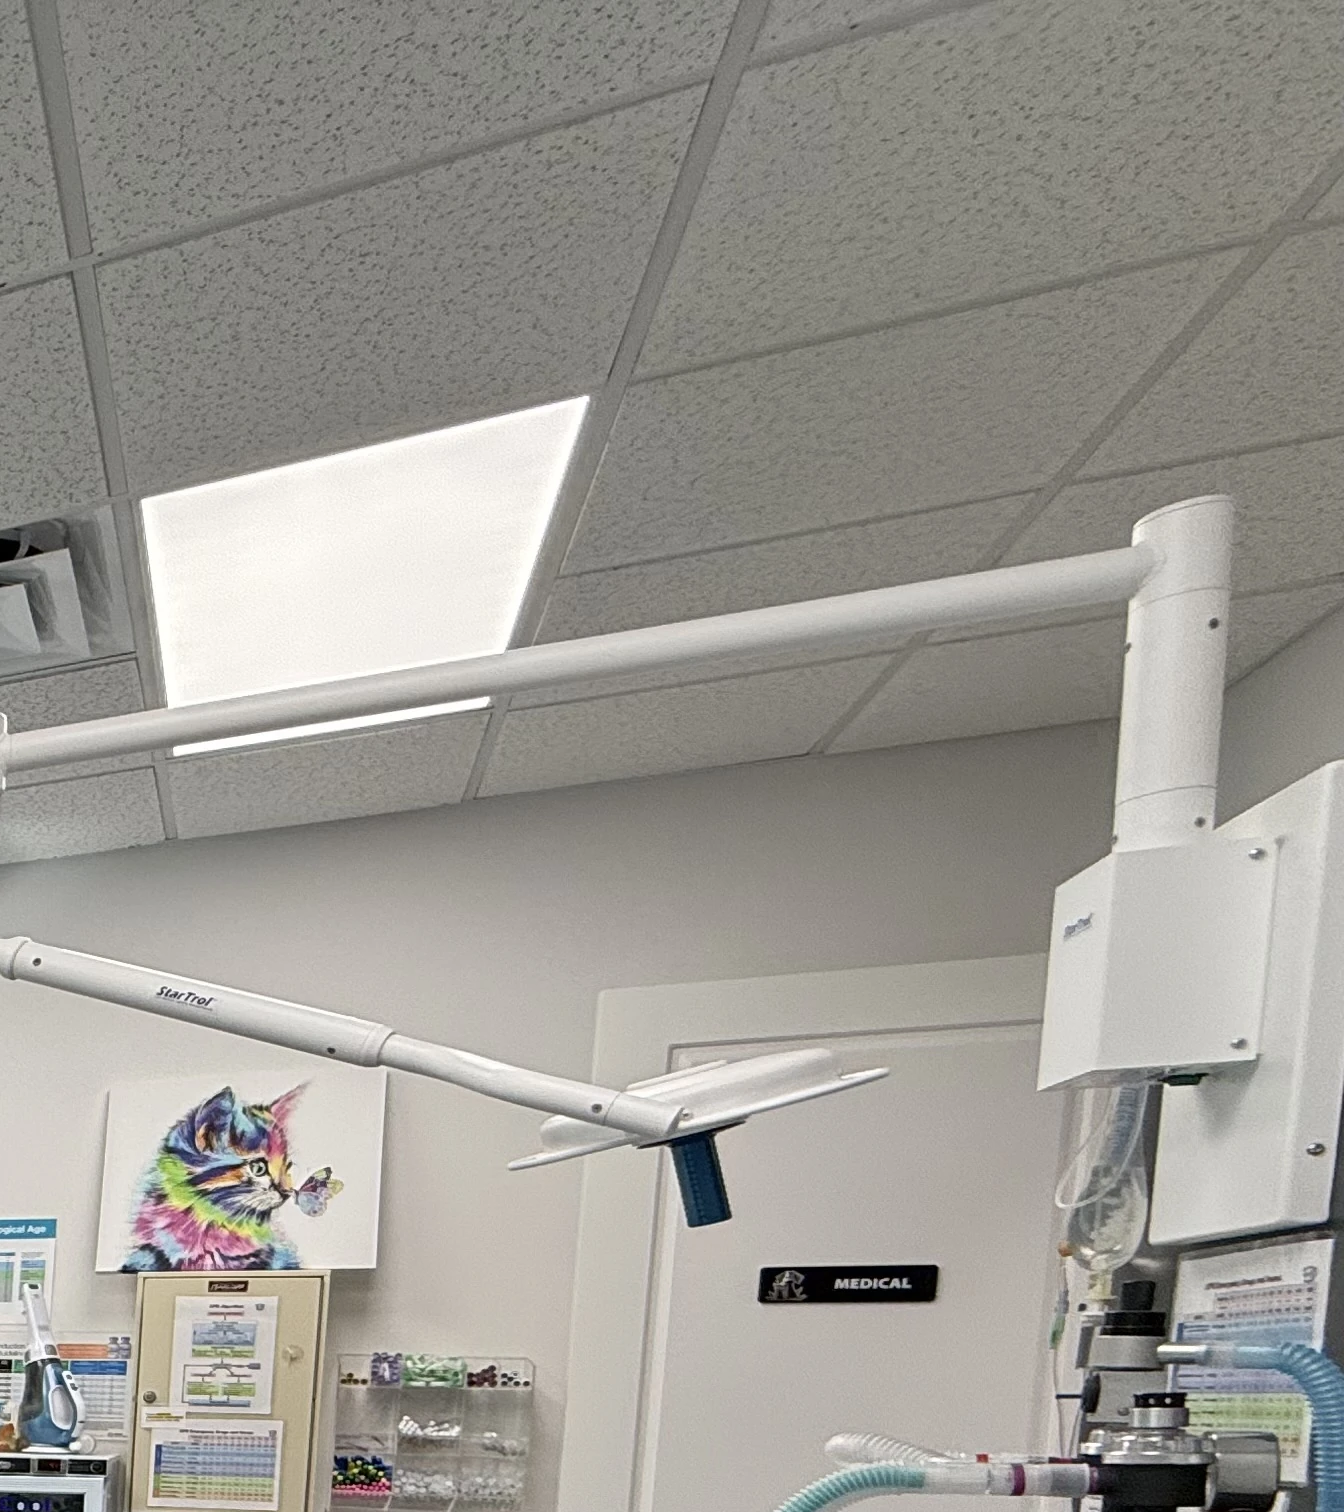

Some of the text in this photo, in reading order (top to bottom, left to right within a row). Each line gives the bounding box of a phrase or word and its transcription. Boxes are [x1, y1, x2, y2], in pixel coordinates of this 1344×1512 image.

[156, 985, 214, 1007] StarTrol
[27, 1225, 47, 1234] Age
[834, 1277, 912, 1290] MEDICAL
